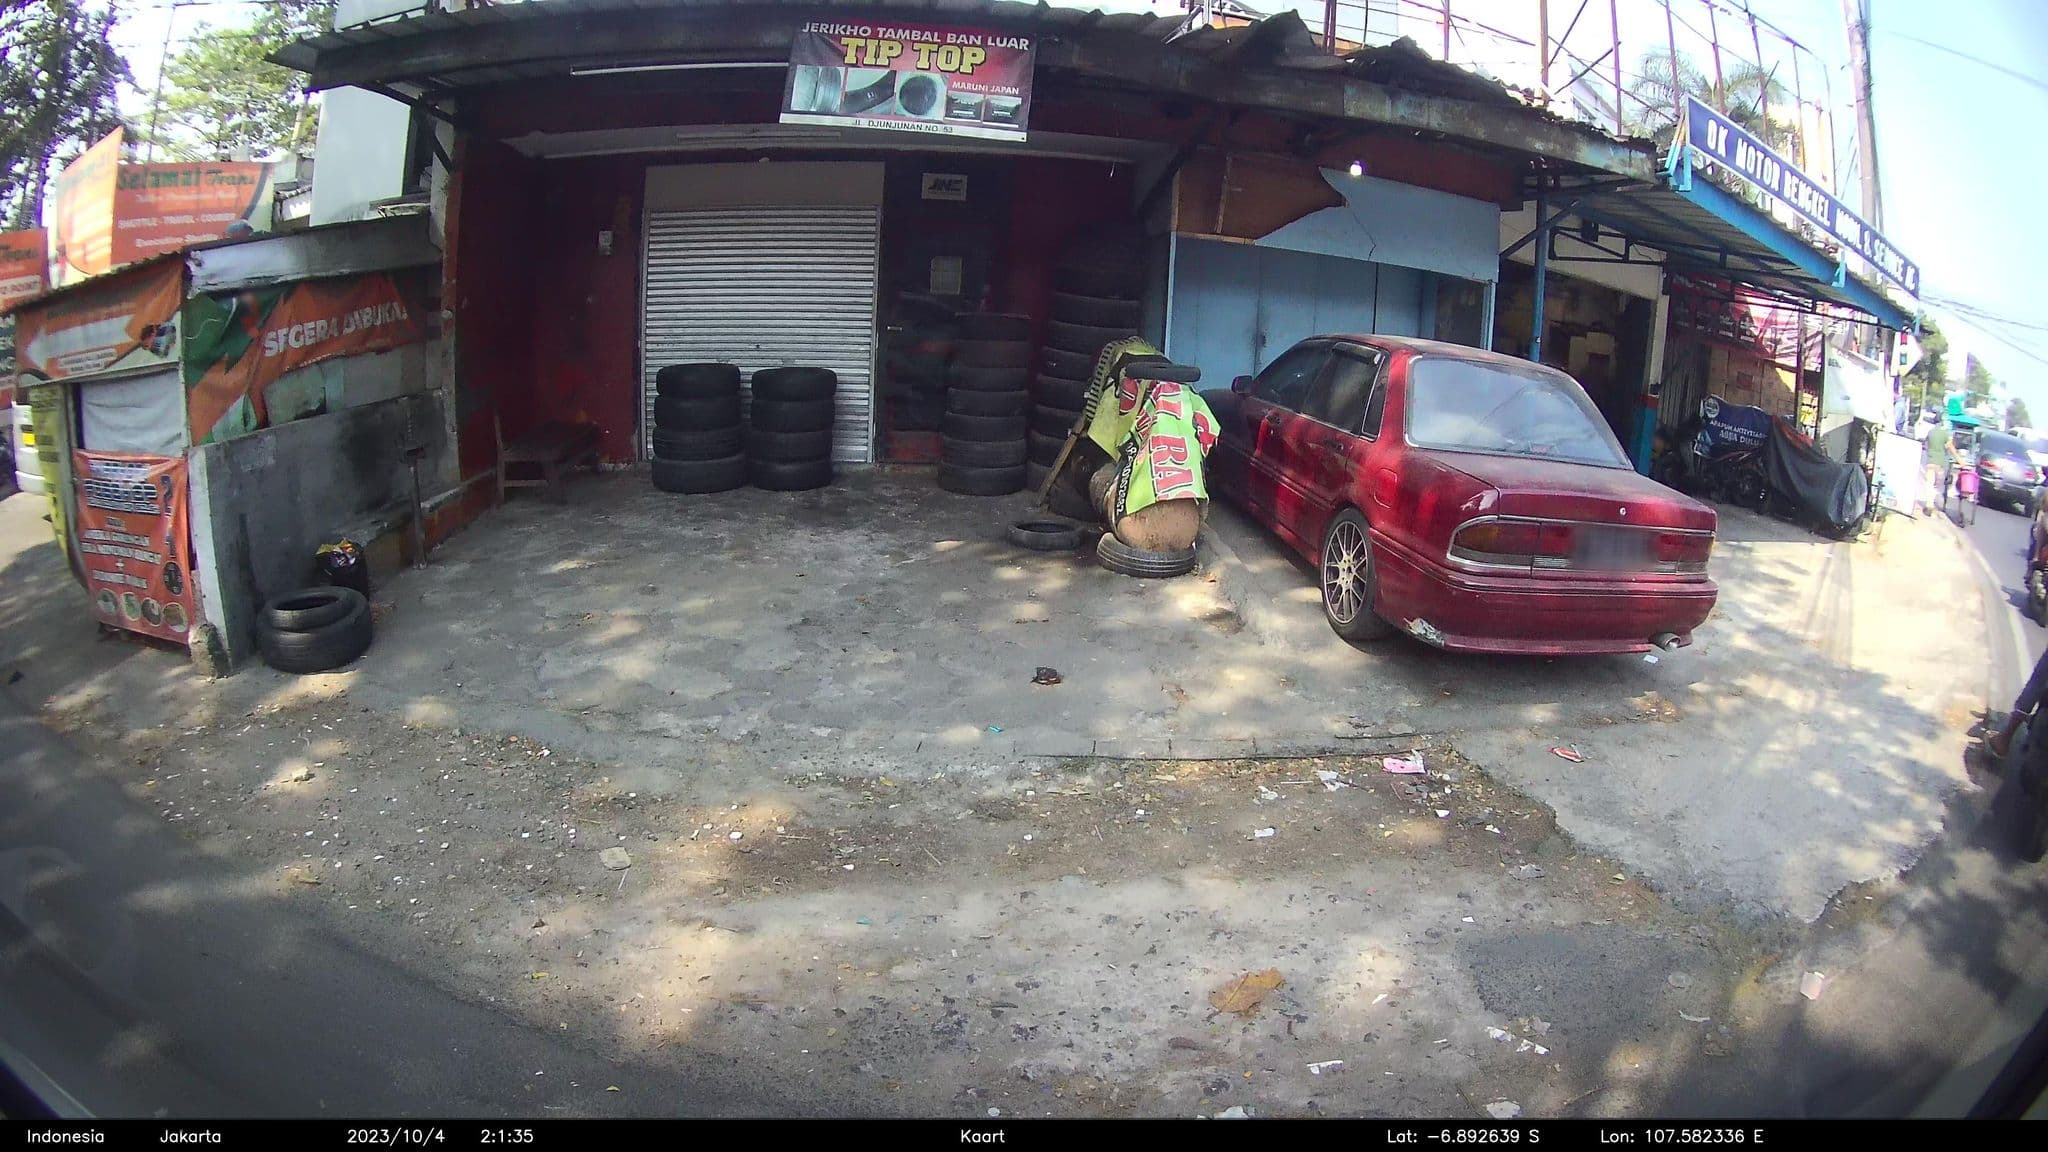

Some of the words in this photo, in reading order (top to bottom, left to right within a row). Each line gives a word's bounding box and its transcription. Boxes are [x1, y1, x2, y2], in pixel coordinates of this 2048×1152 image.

[802, 22, 871, 36] JERIKHO
[877, 27, 941, 42] TAMBAL
[946, 33, 982, 45] BAN
[987, 36, 1029, 51] LUAR
[840, 36, 903, 67] TIP
[911, 42, 987, 75] TOP
[952, 81, 988, 92] MARUNI
[990, 86, 1019, 95] JAPAN
[868, 119, 922, 131] DJUNJUNAN
[1706, 119, 1729, 158] OK
[1735, 138, 1782, 192] MOTOR
